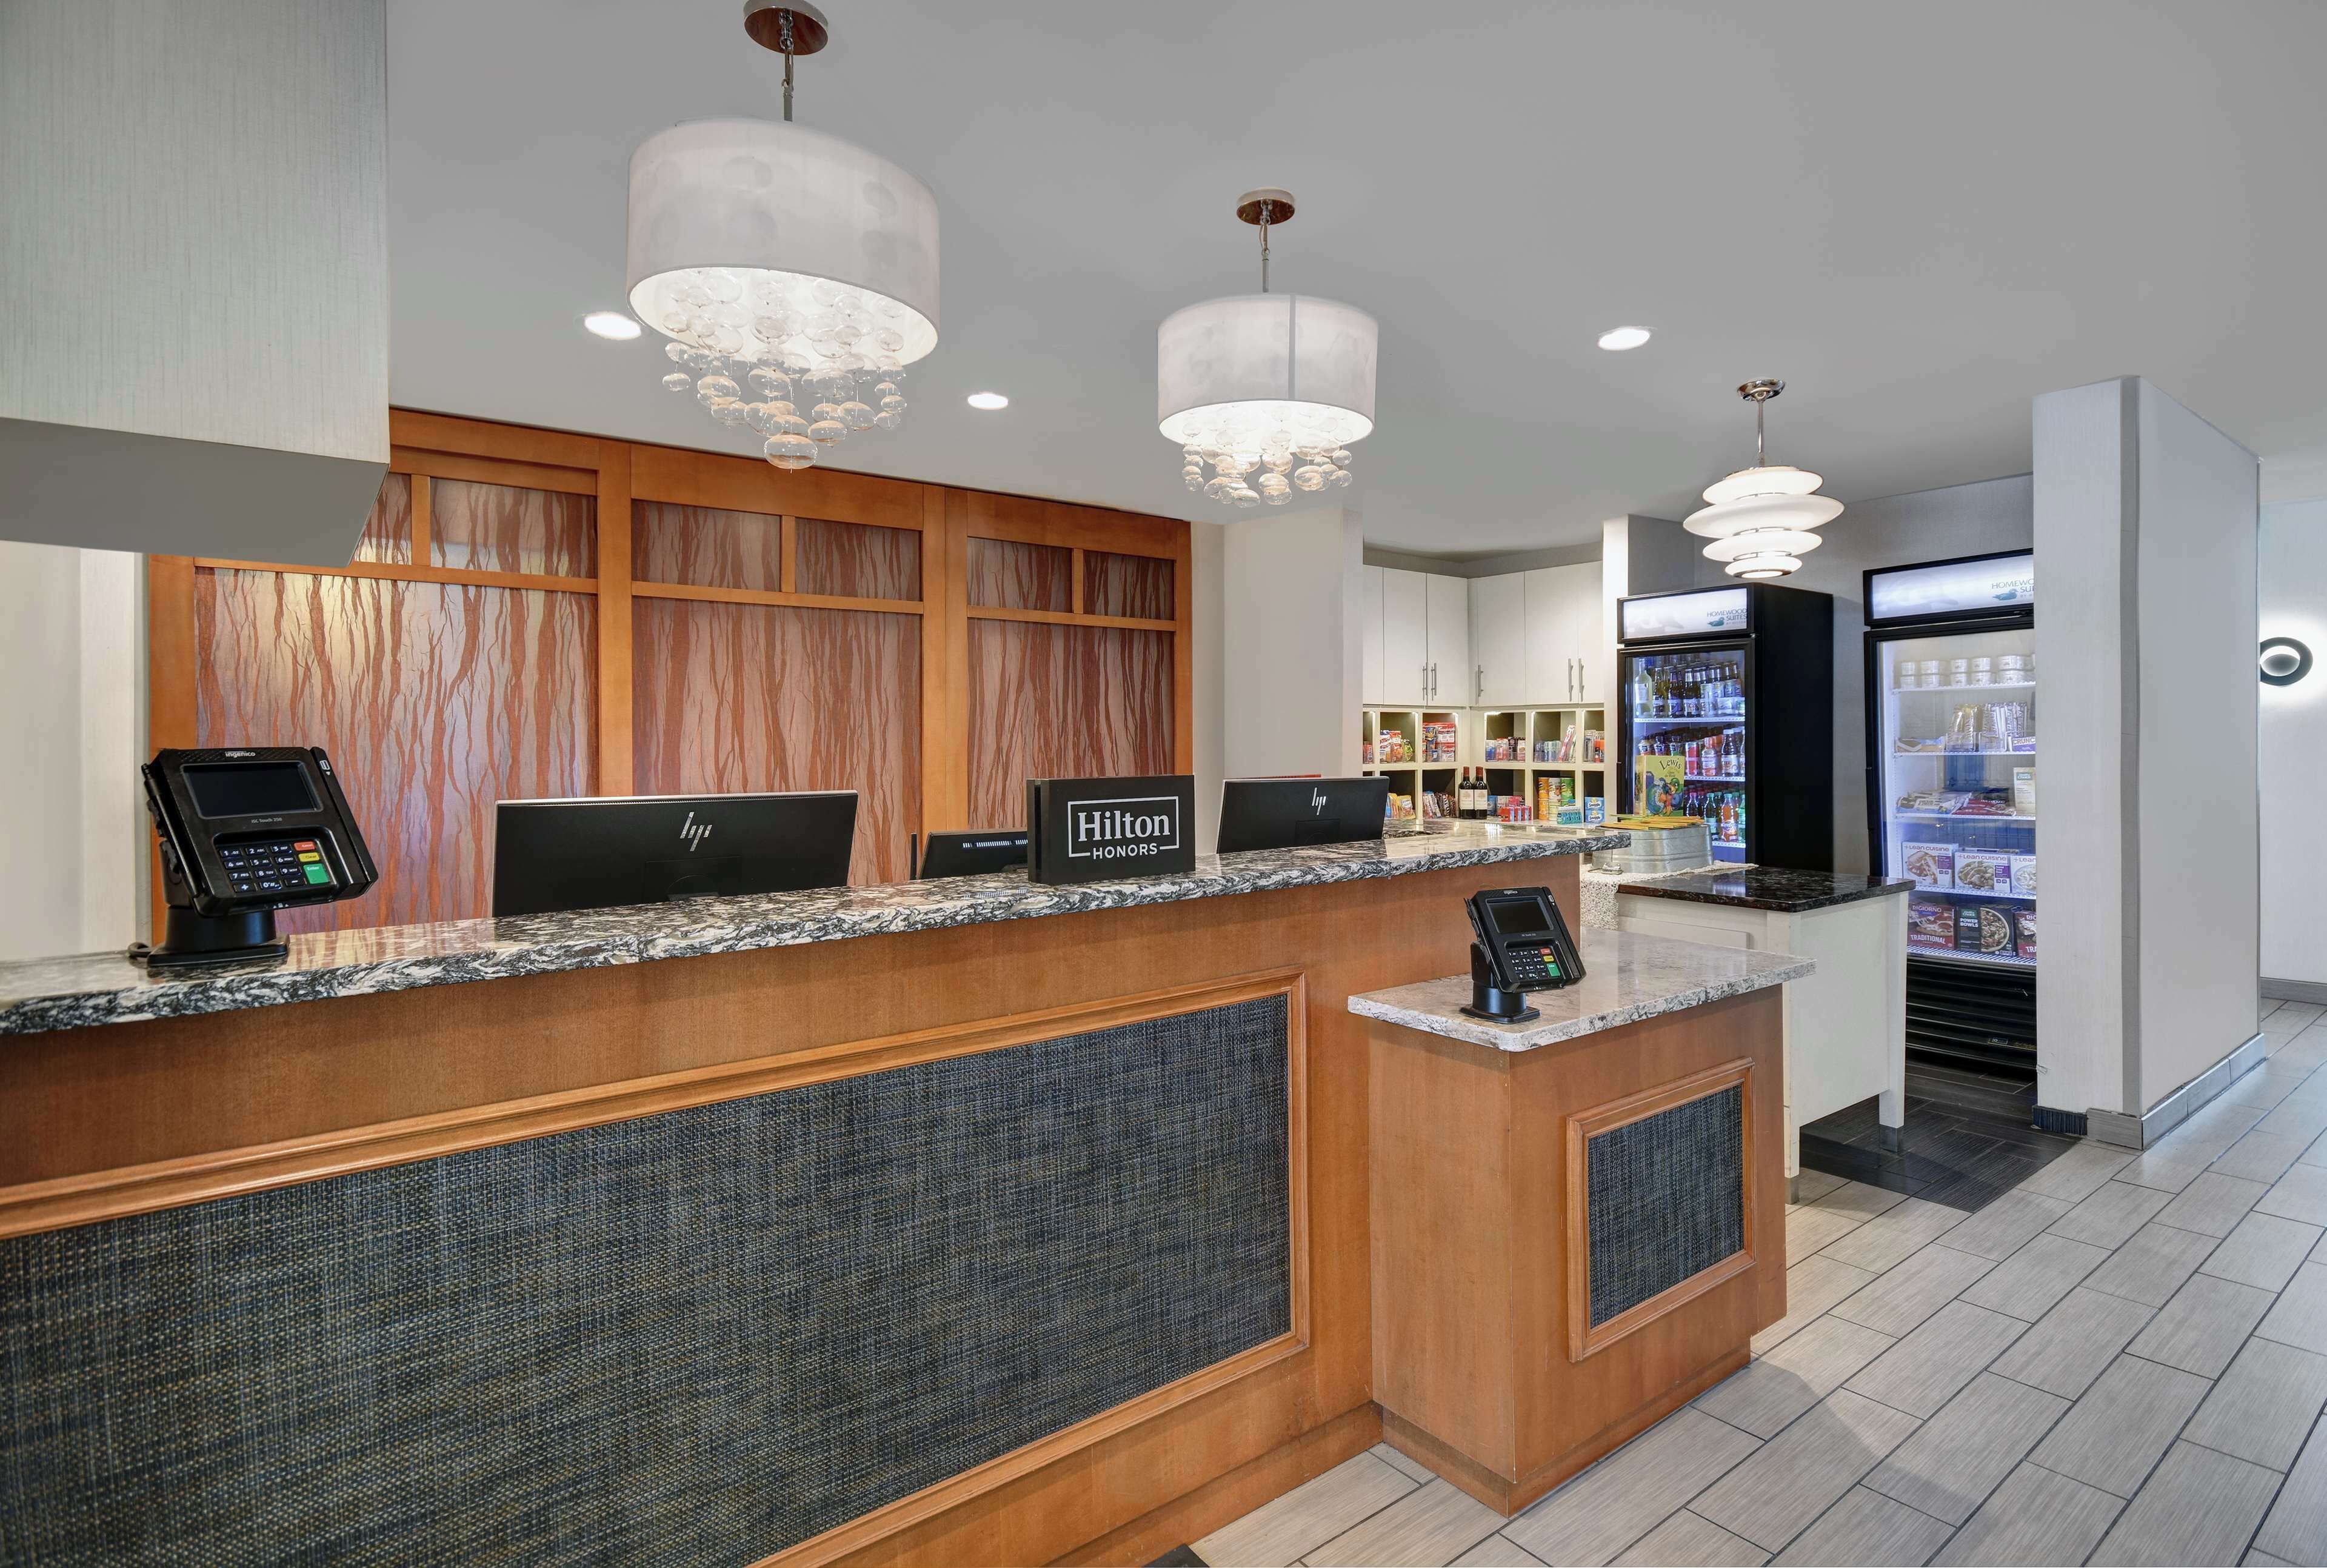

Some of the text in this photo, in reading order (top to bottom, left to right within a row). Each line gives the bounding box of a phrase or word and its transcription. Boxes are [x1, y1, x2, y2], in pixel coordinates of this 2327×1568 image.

[1660, 758, 1681, 770] Lewis
[1078, 810, 1170, 841] Hilton
[1093, 843, 1157, 859] HONORS
[1911, 935, 1946, 944] TRADITIONAL
